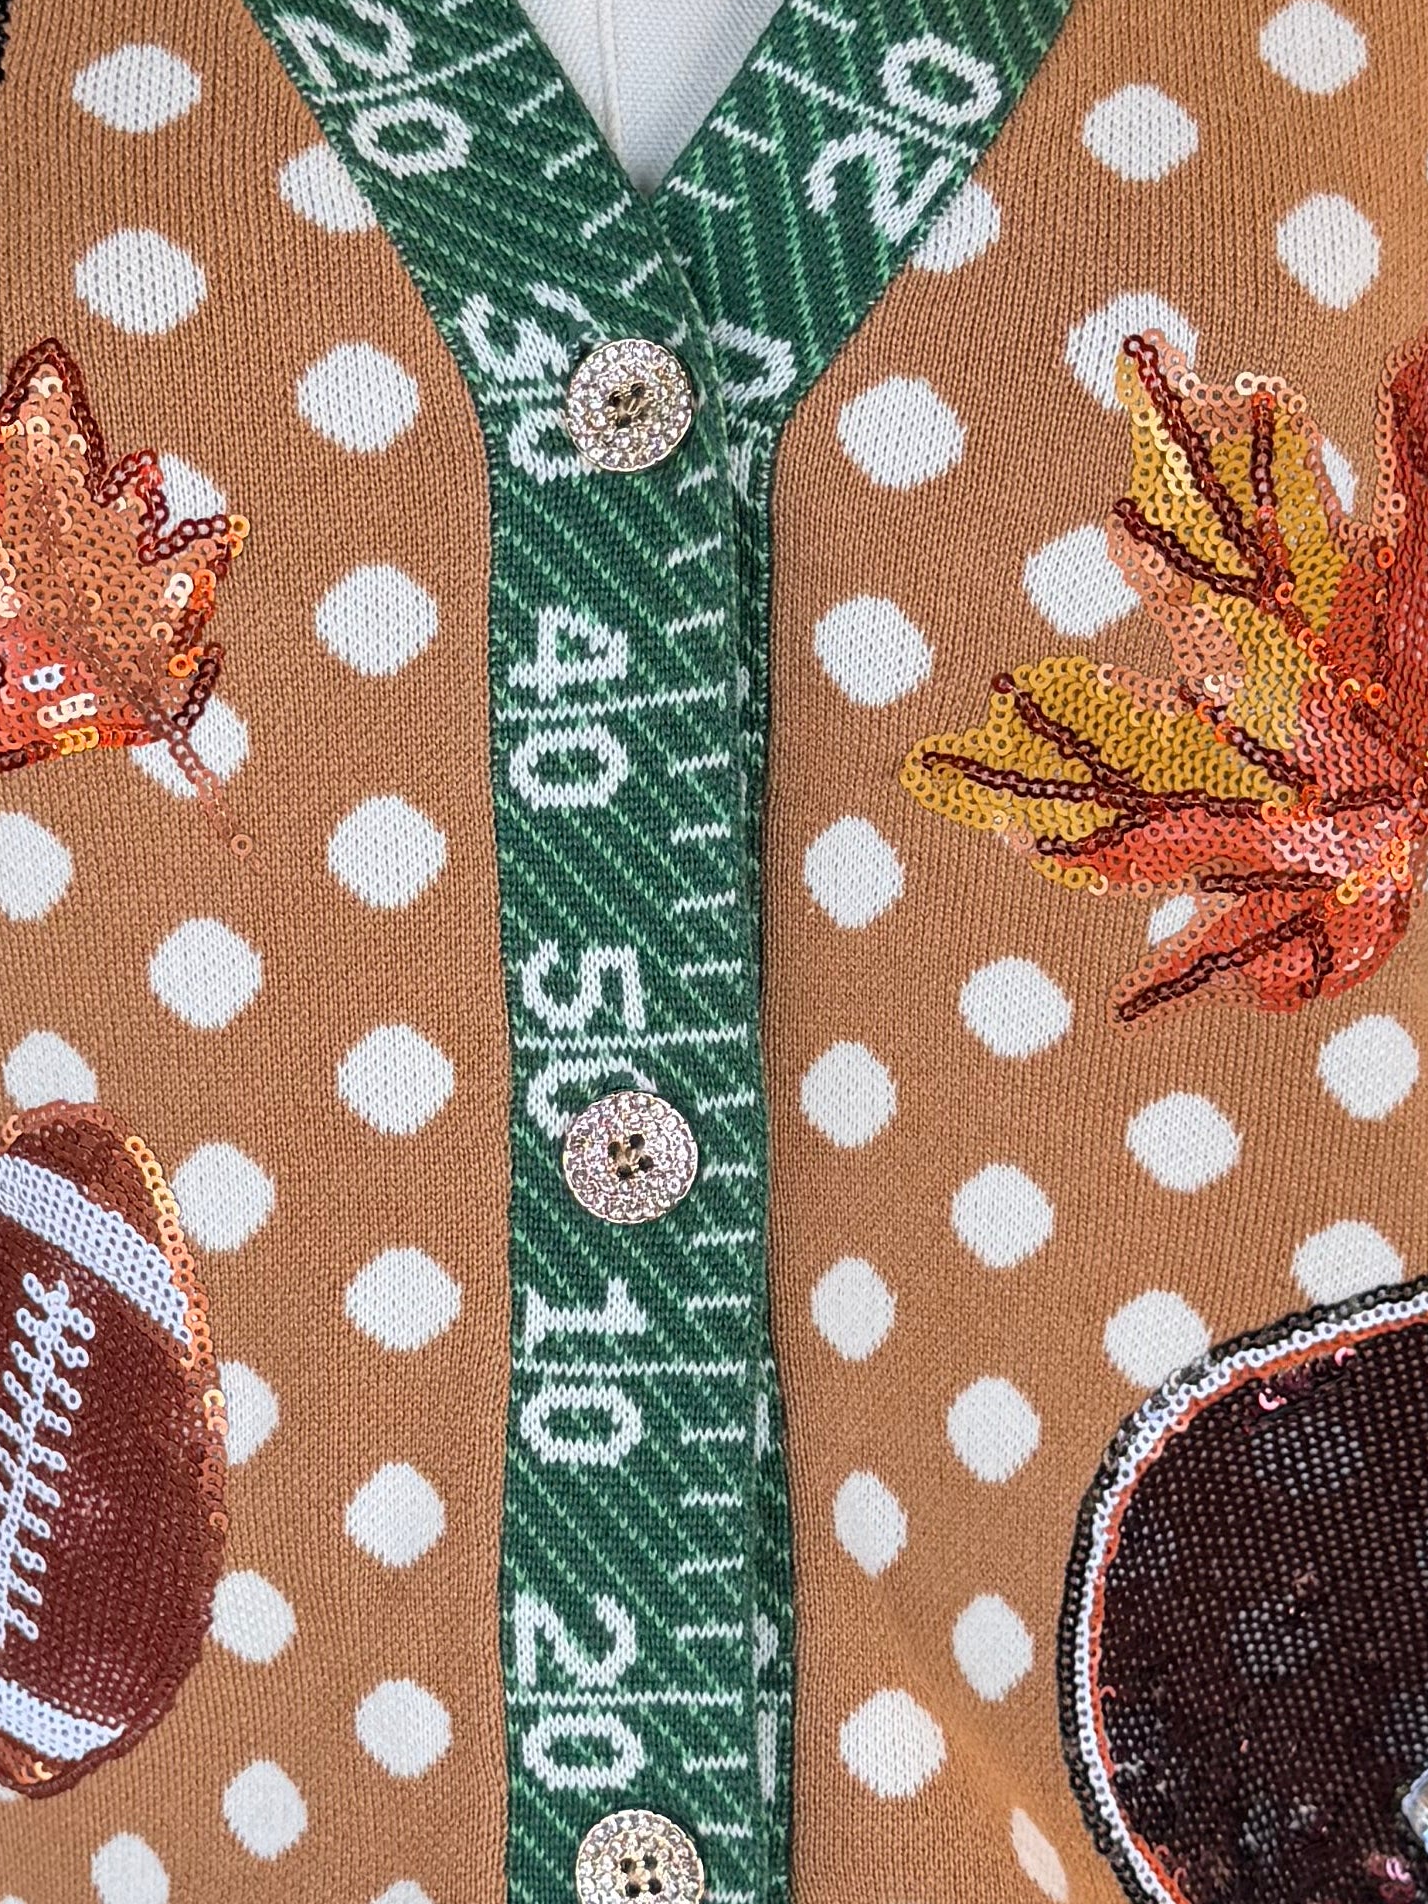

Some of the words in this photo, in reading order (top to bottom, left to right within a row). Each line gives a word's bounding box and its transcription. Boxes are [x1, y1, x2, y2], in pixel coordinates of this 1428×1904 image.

[804, 31, 1002, 246] 20
[507, 602, 630, 813] 40
[518, 1276, 649, 1468] 10
[512, 1591, 646, 1794] 20
